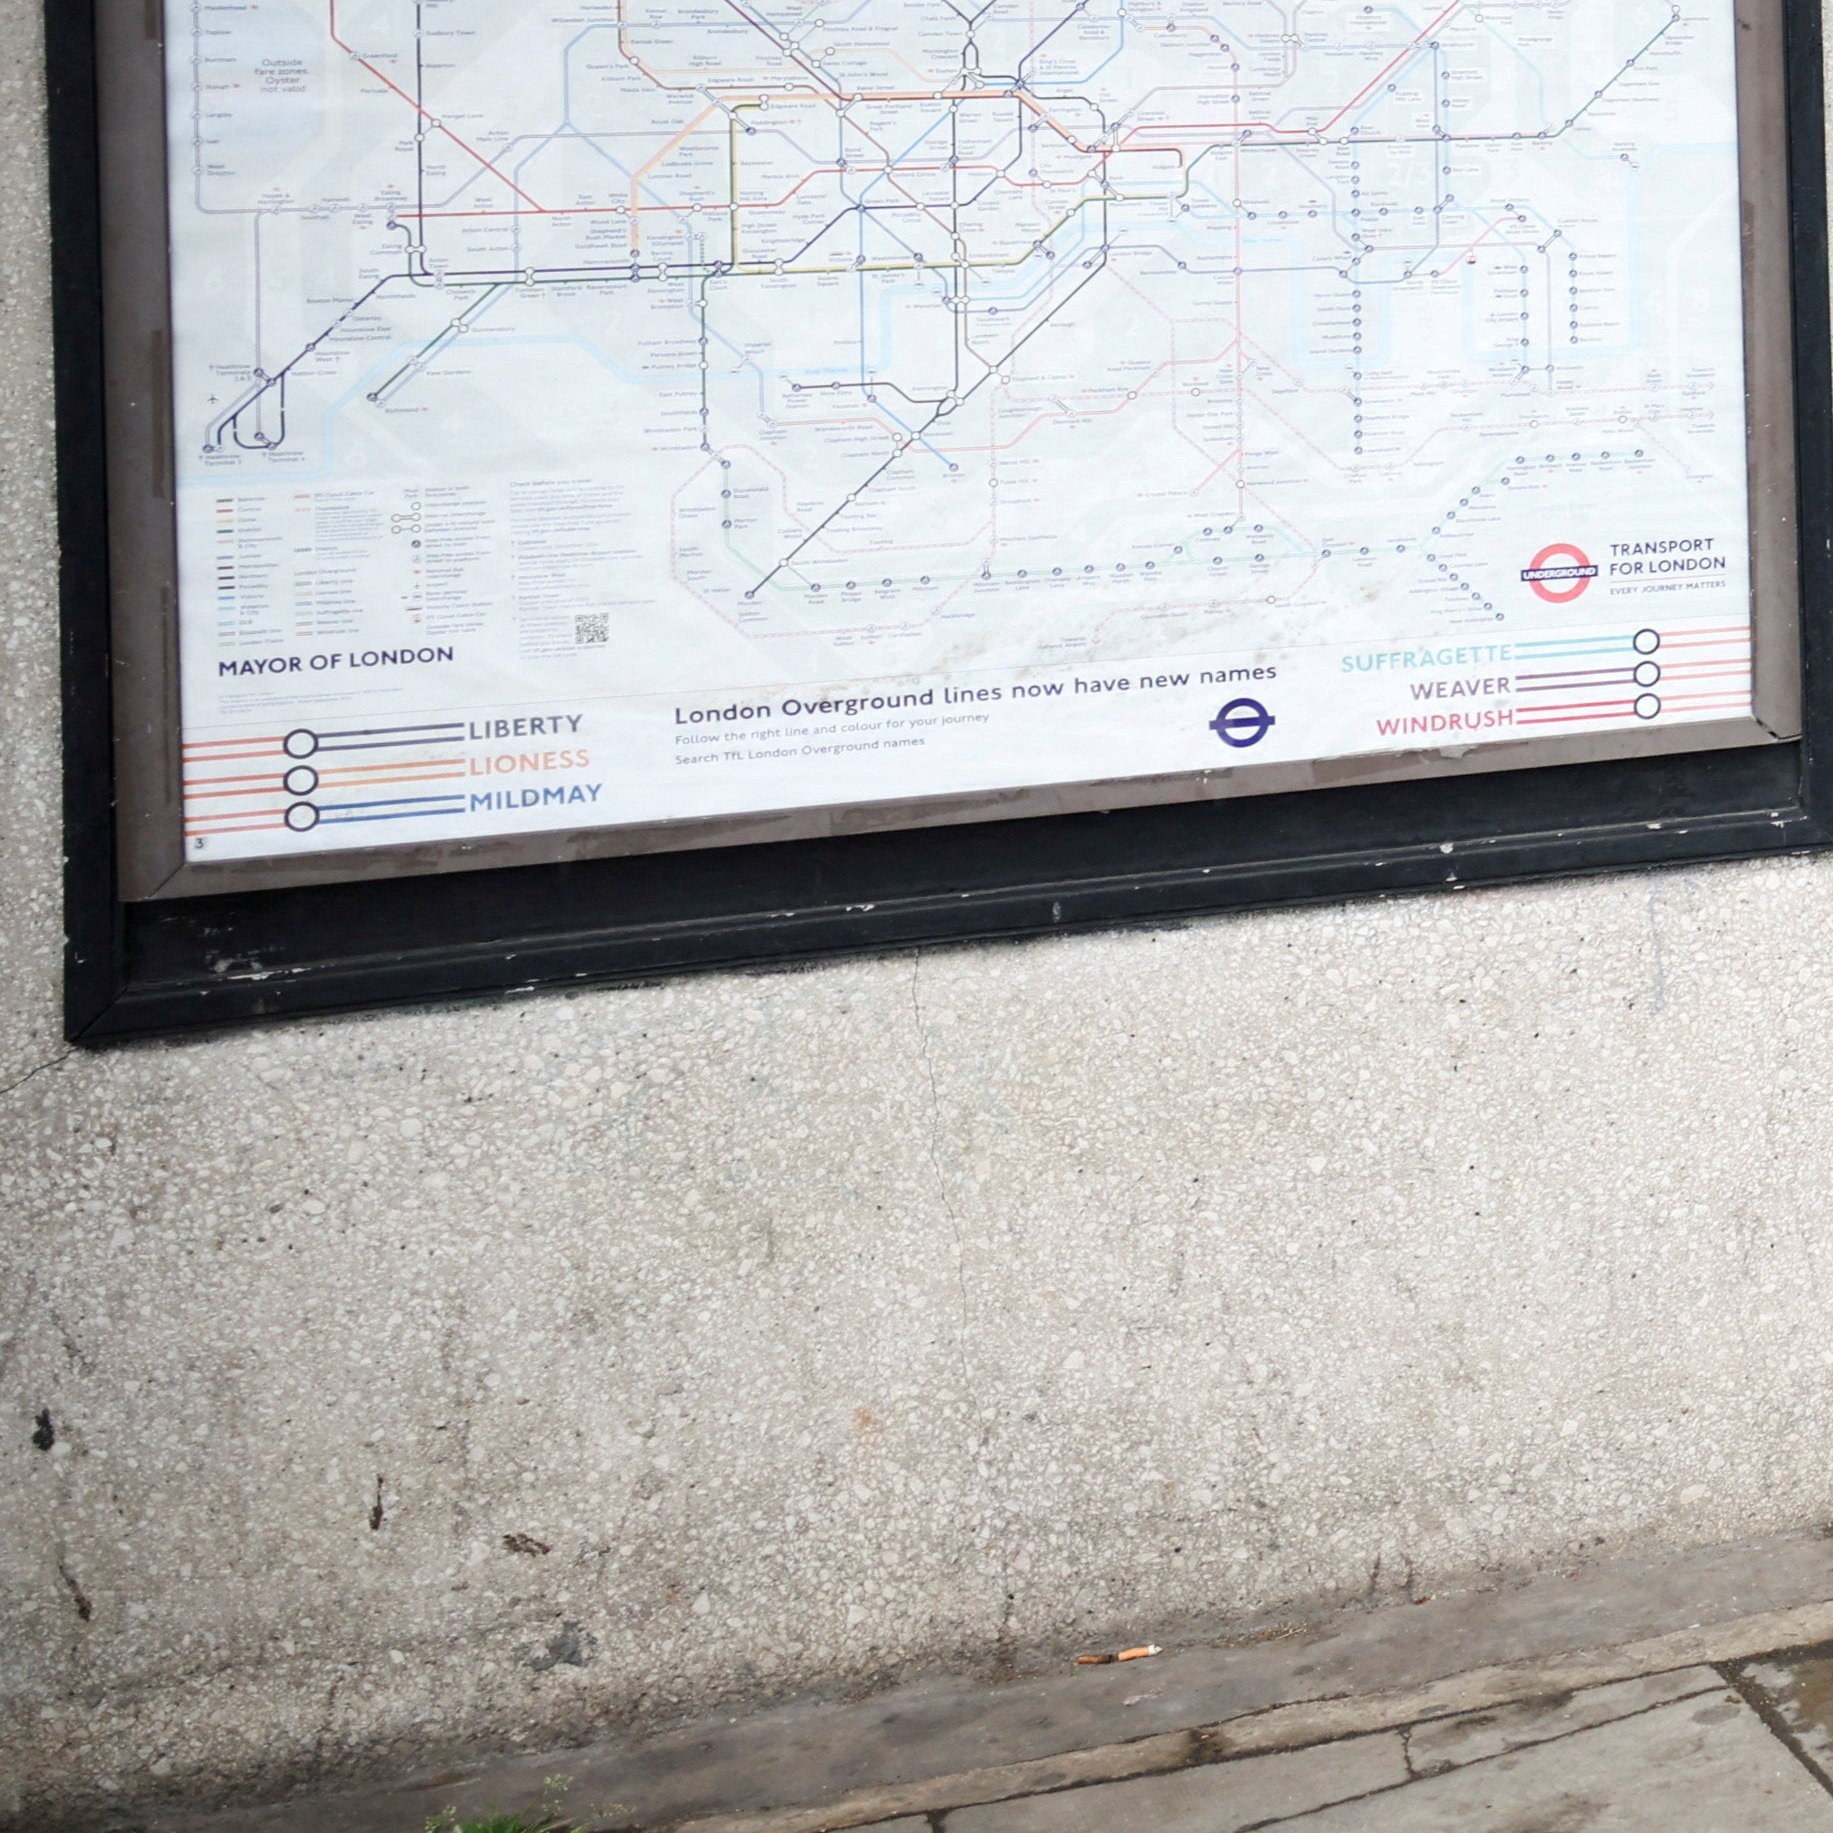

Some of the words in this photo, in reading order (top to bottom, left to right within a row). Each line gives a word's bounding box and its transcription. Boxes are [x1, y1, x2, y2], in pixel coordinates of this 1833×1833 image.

[261, 58, 303, 67] Outside
[265, 76, 300, 85] Oyster
[279, 85, 306, 94] valid
[1610, 538, 1714, 557] TRANSPORT
[1522, 566, 1597, 580] UNDERGROUND
[1610, 560, 1644, 577] FOR
[1649, 556, 1726, 574] LONDON
[1610, 587, 1638, 595] EVERY
[1641, 584, 1683, 593] JOURNEY
[1685, 580, 1726, 590] MATTERS
[219, 657, 302, 677] MAYOR
[310, 654, 342, 671] OF
[349, 647, 455, 669] LONDON
[1341, 643, 1512, 674] SUFFRAGETTE
[675, 702, 771, 725] London
[782, 689, 934, 718] Overground
[944, 685, 1002, 706] lines
[1011, 682, 1064, 700] now
[1073, 676, 1131, 696] have
[1140, 672, 1190, 690] new
[1200, 665, 1277, 685] names
[1411, 677, 1511, 700] WEAVER
[469, 714, 583, 741] LIBERTY
[675, 733, 719, 746] Follow
[723, 731, 746, 744] the
[750, 728, 781, 743] right
[784, 726, 809, 739] line
[813, 724, 836, 737] and
[840, 721, 882, 735] colour
[886, 718, 905, 731] for
[908, 718, 937, 732] your
[940, 712, 990, 727] journey
[1376, 708, 1514, 736] WINDRUSH
[470, 748, 591, 777] LIONESS
[675, 752, 719, 765] Search
[723, 750, 744, 763] TfL
[748, 747, 798, 761] London
[802, 741, 880, 758] Overground
[883, 737, 925, 749] names
[470, 783, 603, 813] MILDMAY
